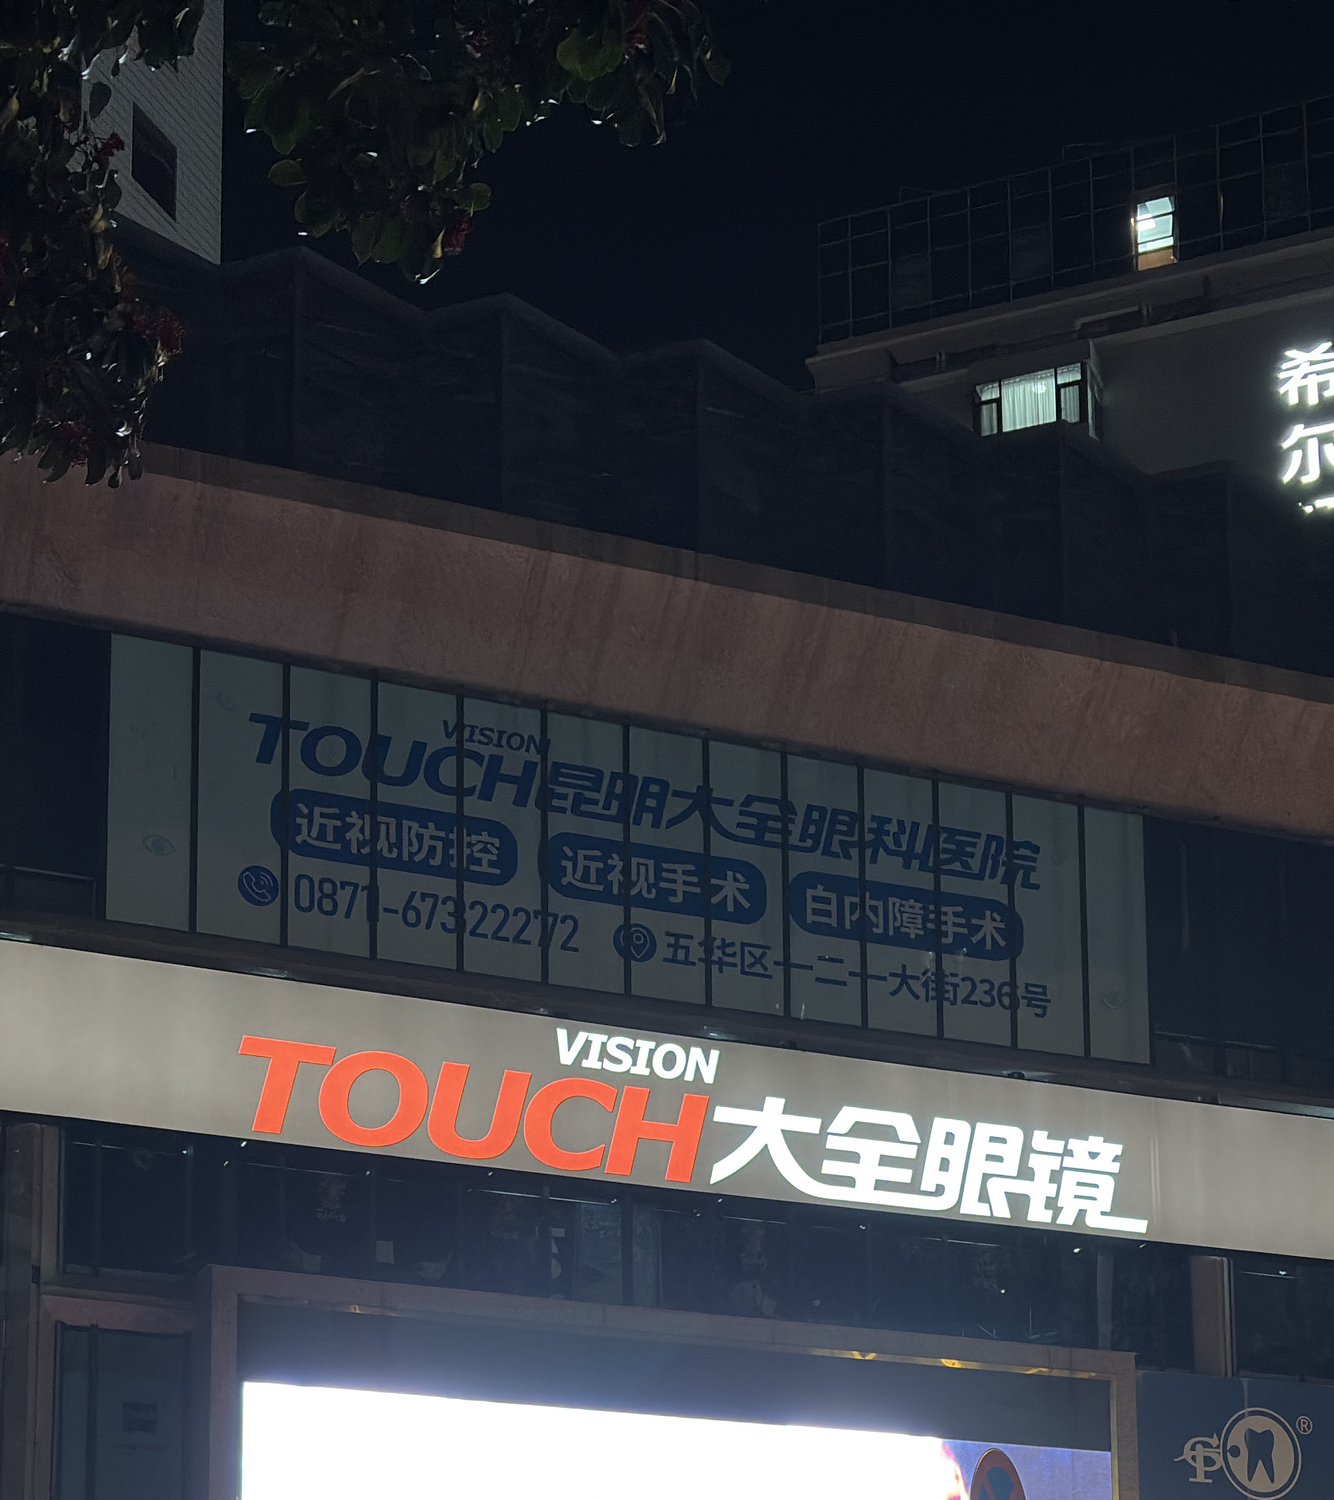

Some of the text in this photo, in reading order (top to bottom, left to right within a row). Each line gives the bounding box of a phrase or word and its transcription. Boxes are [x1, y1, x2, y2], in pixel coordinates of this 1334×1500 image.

[248, 712, 1041, 891] TOUCH 昆明大全眼科医院
[442, 719, 551, 756] VISION
[294, 802, 1008, 951] 近视防控 近视手术 白内障手术
[555, 1027, 720, 1085] VISION
[239, 1034, 1149, 1234] TOUCH 大全眼镜
